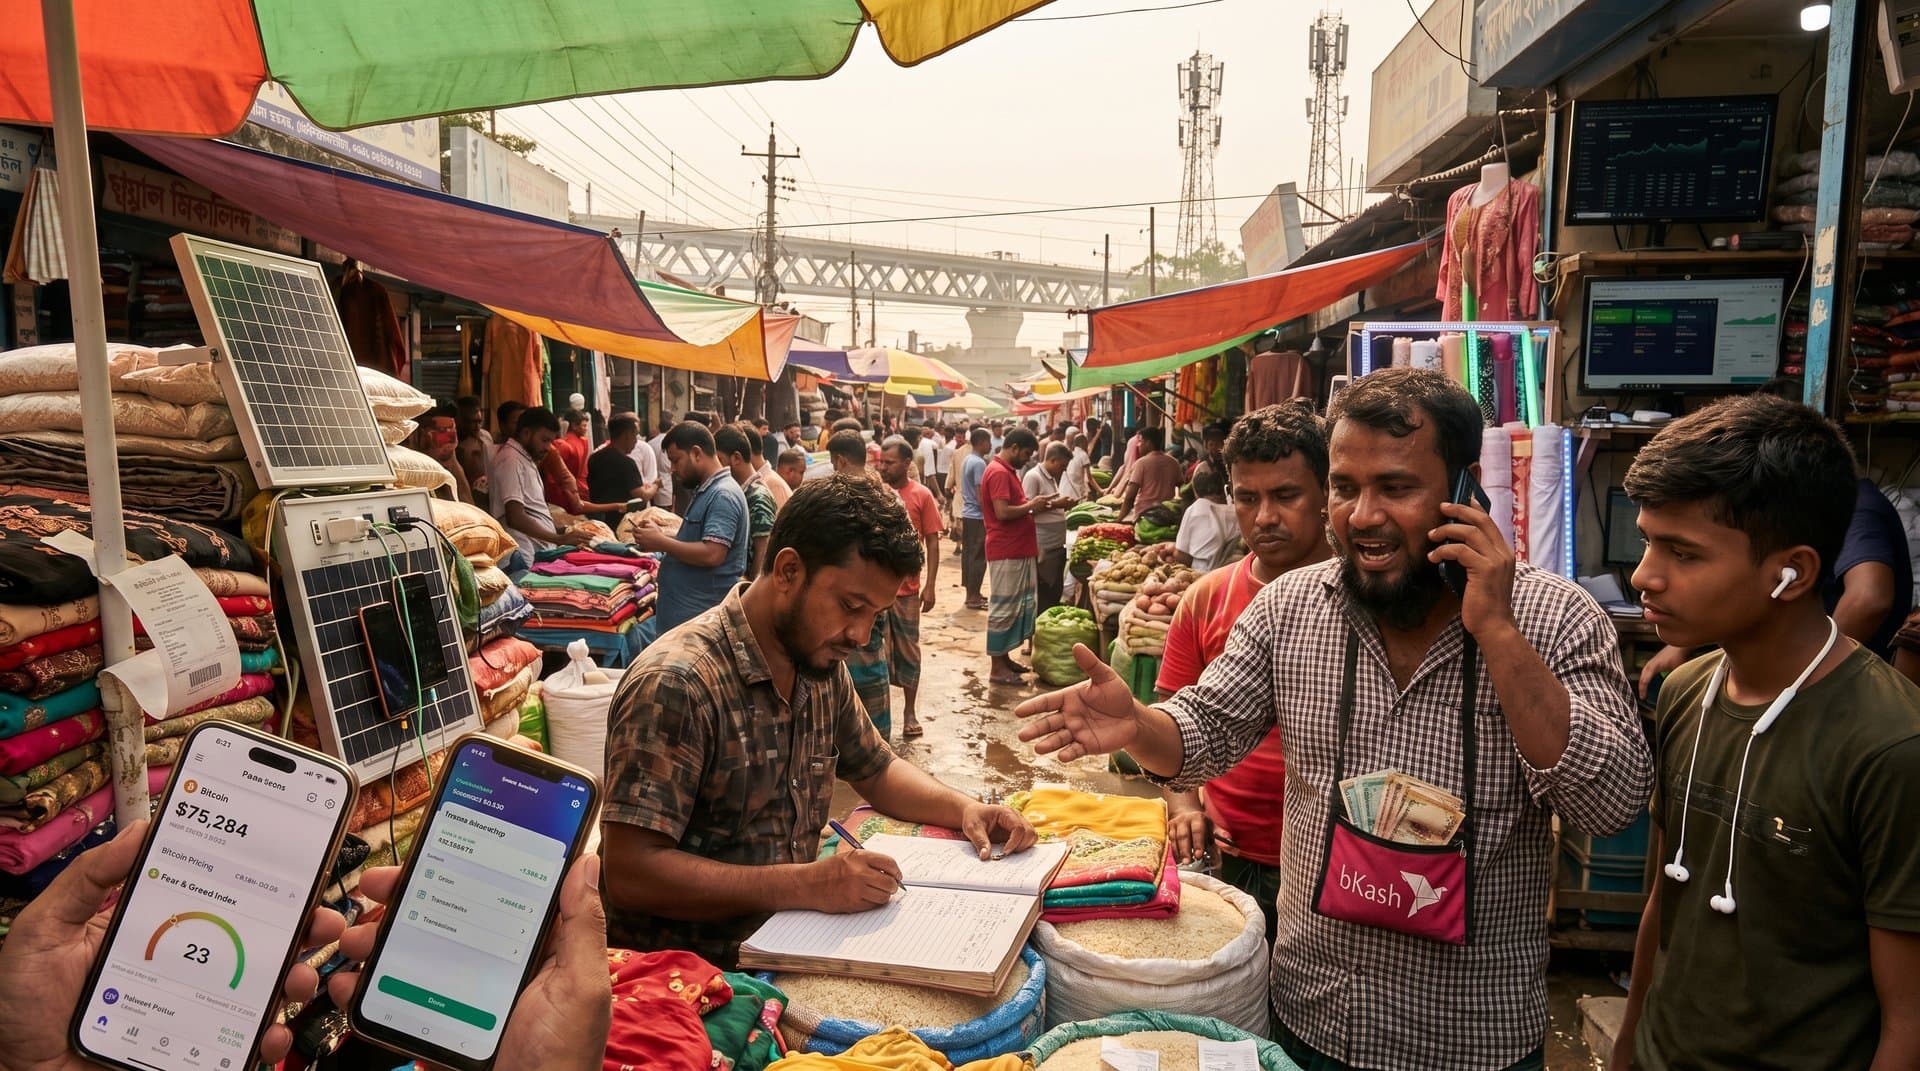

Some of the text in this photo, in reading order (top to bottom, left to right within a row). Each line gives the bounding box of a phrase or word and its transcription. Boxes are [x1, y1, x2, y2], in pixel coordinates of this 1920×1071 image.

[201, 787, 229, 803] Bitcoin
[175, 801, 249, 838] $75,284
[161, 847, 214, 872] Bitcoin Pricing
[161, 873, 238, 906] Fear & Greed Index
[1339, 864, 1401, 909] bKash
[183, 943, 210, 964] 23
